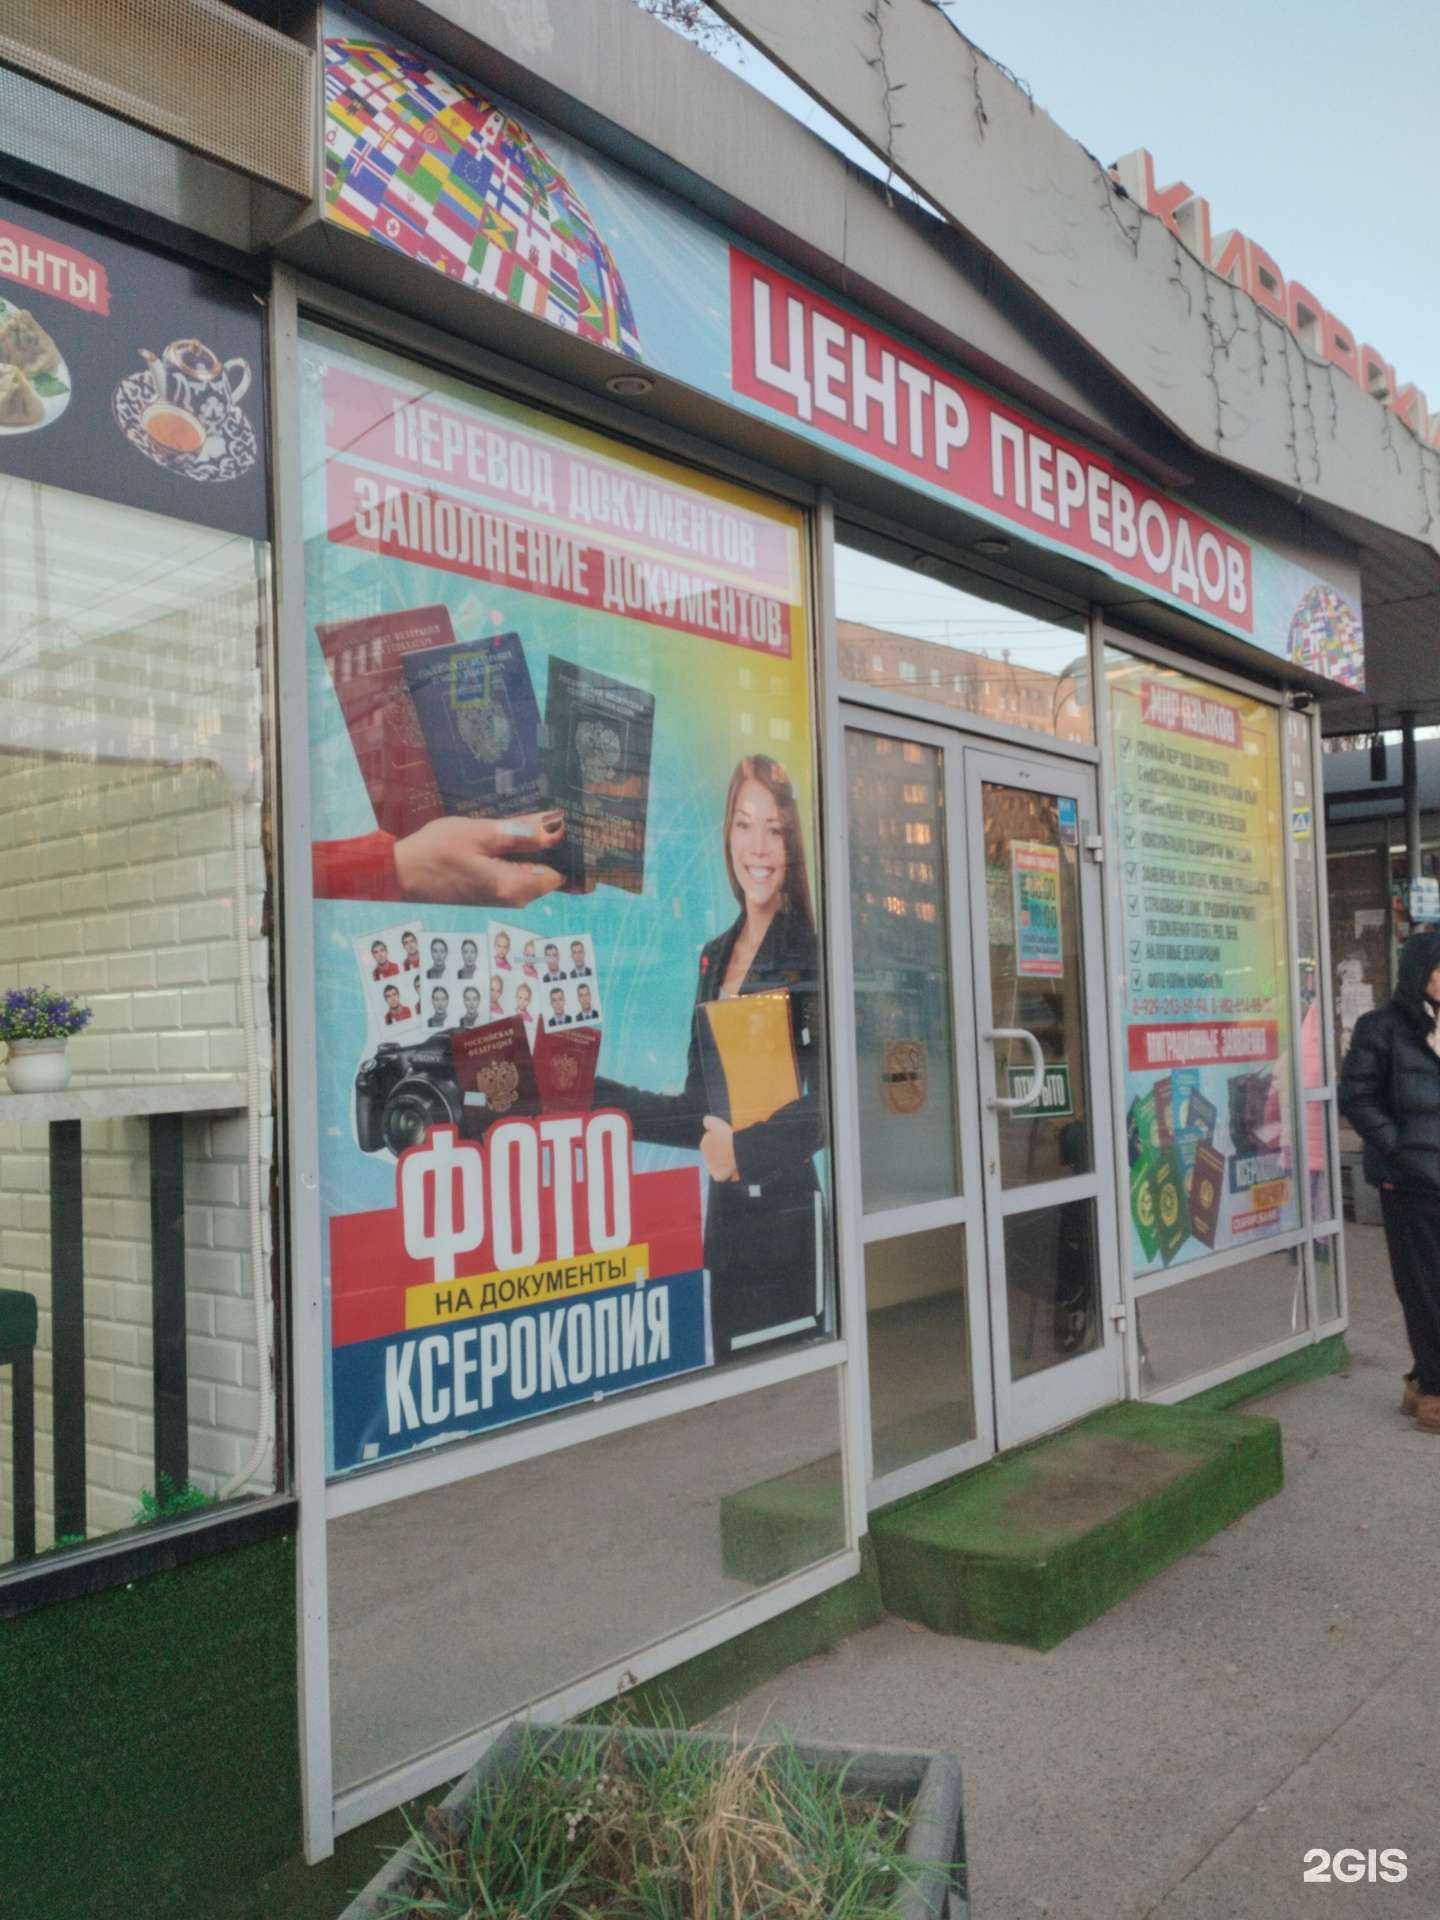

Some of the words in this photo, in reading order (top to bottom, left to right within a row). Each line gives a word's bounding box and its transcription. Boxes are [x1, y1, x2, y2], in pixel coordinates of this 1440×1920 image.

[393, 398, 556, 513] ПЕРЕВОД
[569, 461, 756, 569] ДОКУМЕНТОВ
[753, 278, 970, 470] ЦЕНТР
[989, 412, 1248, 615] ПЕРЕВОДОВ
[353, 476, 590, 595] ЗАПОЛНЕНИЕ
[603, 550, 783, 647] ДОКУМЕНТОВ
[402, 1113, 632, 1282] ФОТО
[385, 1285, 670, 1436] КСЕРОКОПИЯ
[435, 1292, 473, 1316] НА
[479, 1257, 627, 1312] ДОКУМЕНТЫ
